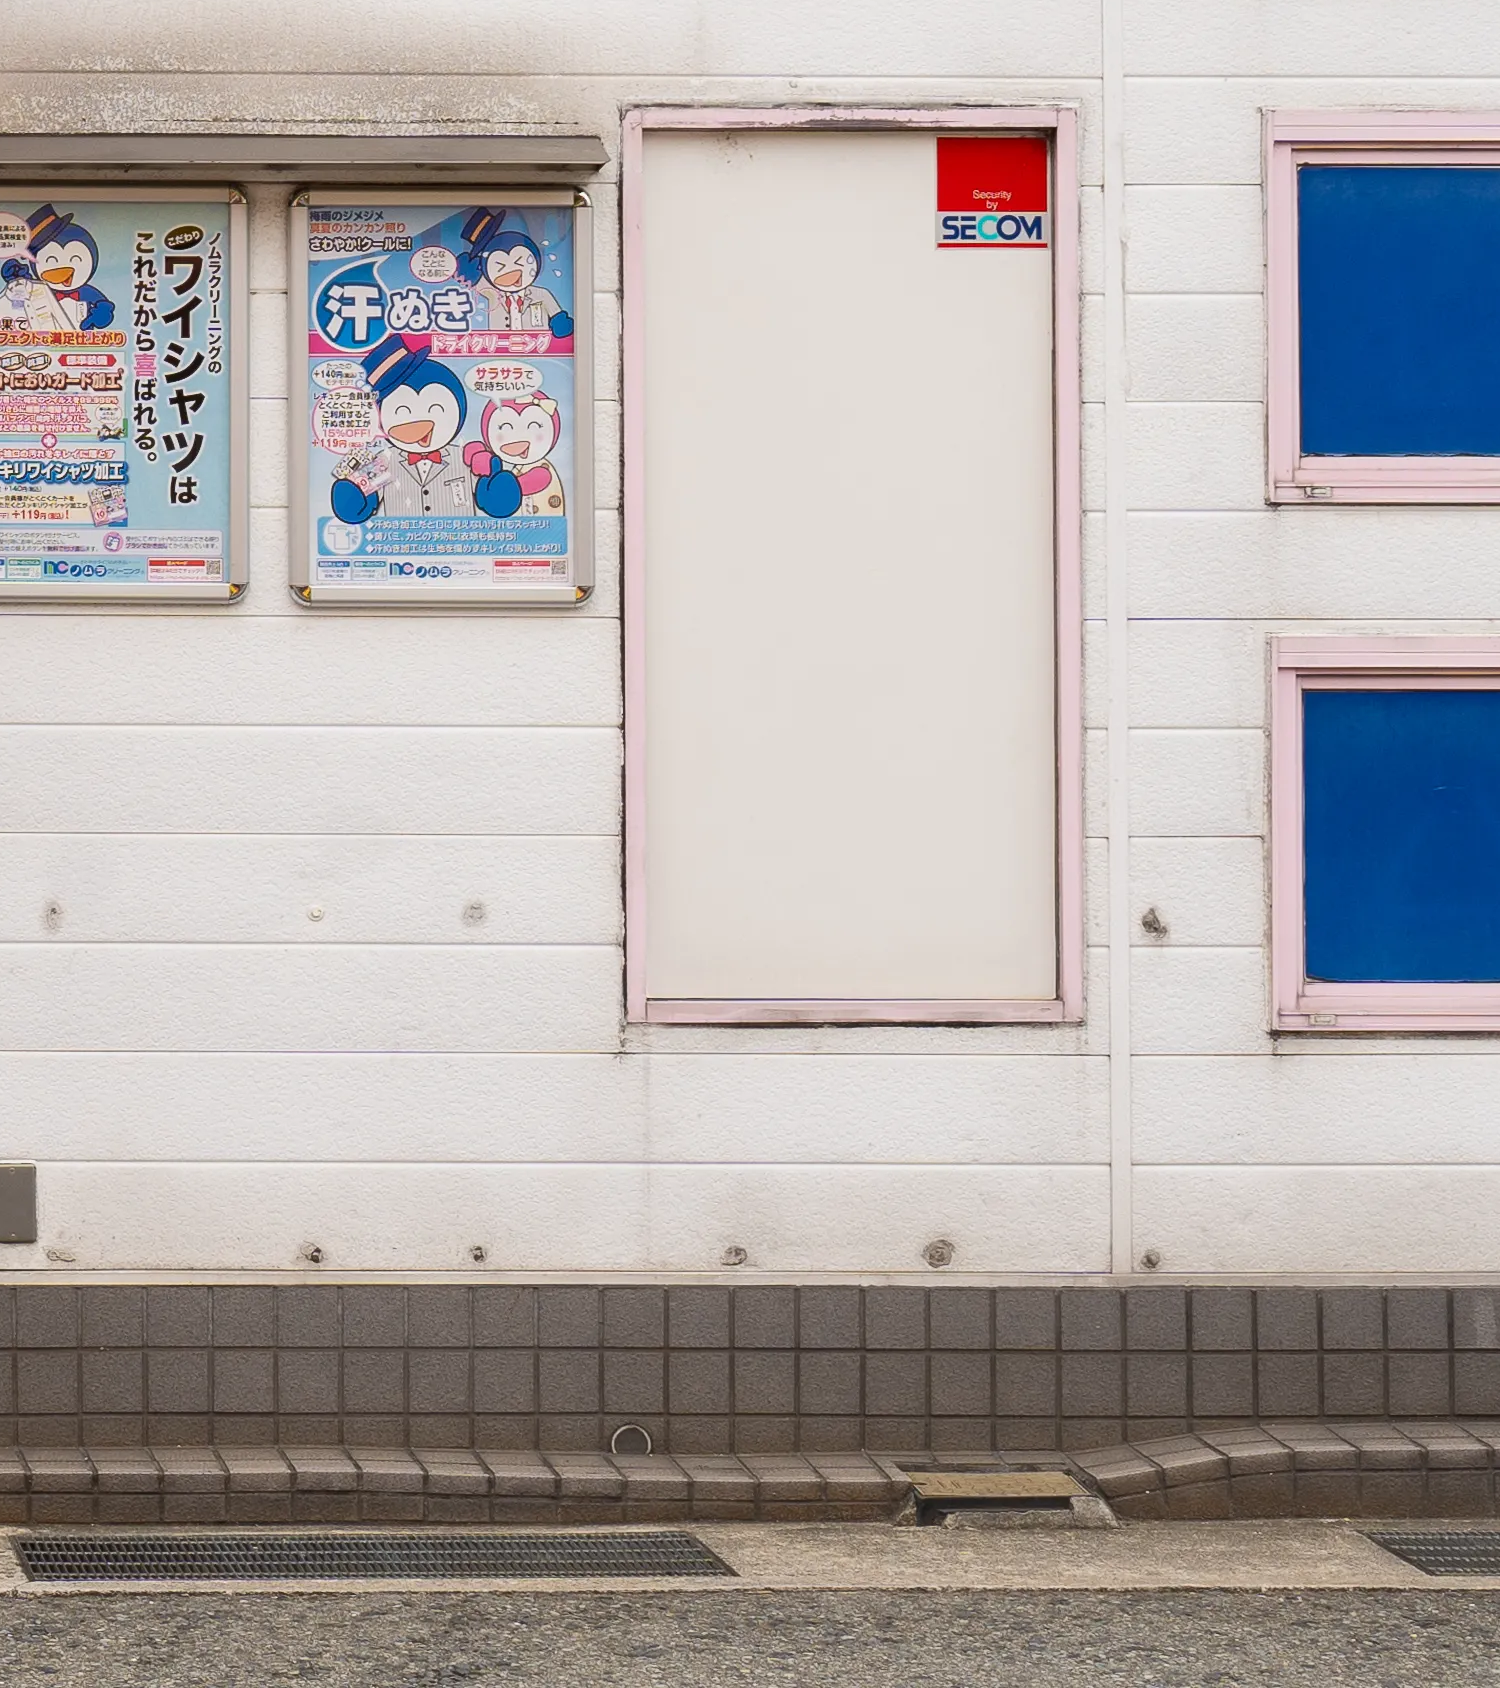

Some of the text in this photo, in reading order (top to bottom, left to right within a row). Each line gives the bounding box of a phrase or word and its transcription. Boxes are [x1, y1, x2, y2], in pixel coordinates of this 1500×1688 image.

[972, 189, 1012, 201] Security
[985, 200, 999, 211] by
[309, 210, 384, 222] 梅雨のジメジメ
[309, 222, 407, 234] 真夏のカンカン照り
[942, 214, 1043, 240] SECOM
[166, 231, 200, 247] こだわり
[309, 236, 412, 252] さわやか!クールに!
[421, 250, 446, 259] こんな
[421, 259, 446, 268] ことに
[207, 232, 221, 374] ノムラクリーニングの
[324, 284, 475, 342] 汗ぬき
[133, 232, 158, 463] これだから喜ばれる。
[431, 333, 552, 354] ドライクリーニング
[475, 366, 534, 381] サラサラで
[161, 255, 206, 505] ワイシャツは
[473, 381, 536, 392] 気持ちいい～
[313, 391, 379, 401] レギュラー会員様が
[318, 401, 373, 410] とくとくカードを
[322, 410, 371, 419] ご利用すると
[321, 419, 372, 428] 汗ぬき加工が
[70, 565, 107, 577] ノムラ
[415, 566, 453, 578] ノムラ
